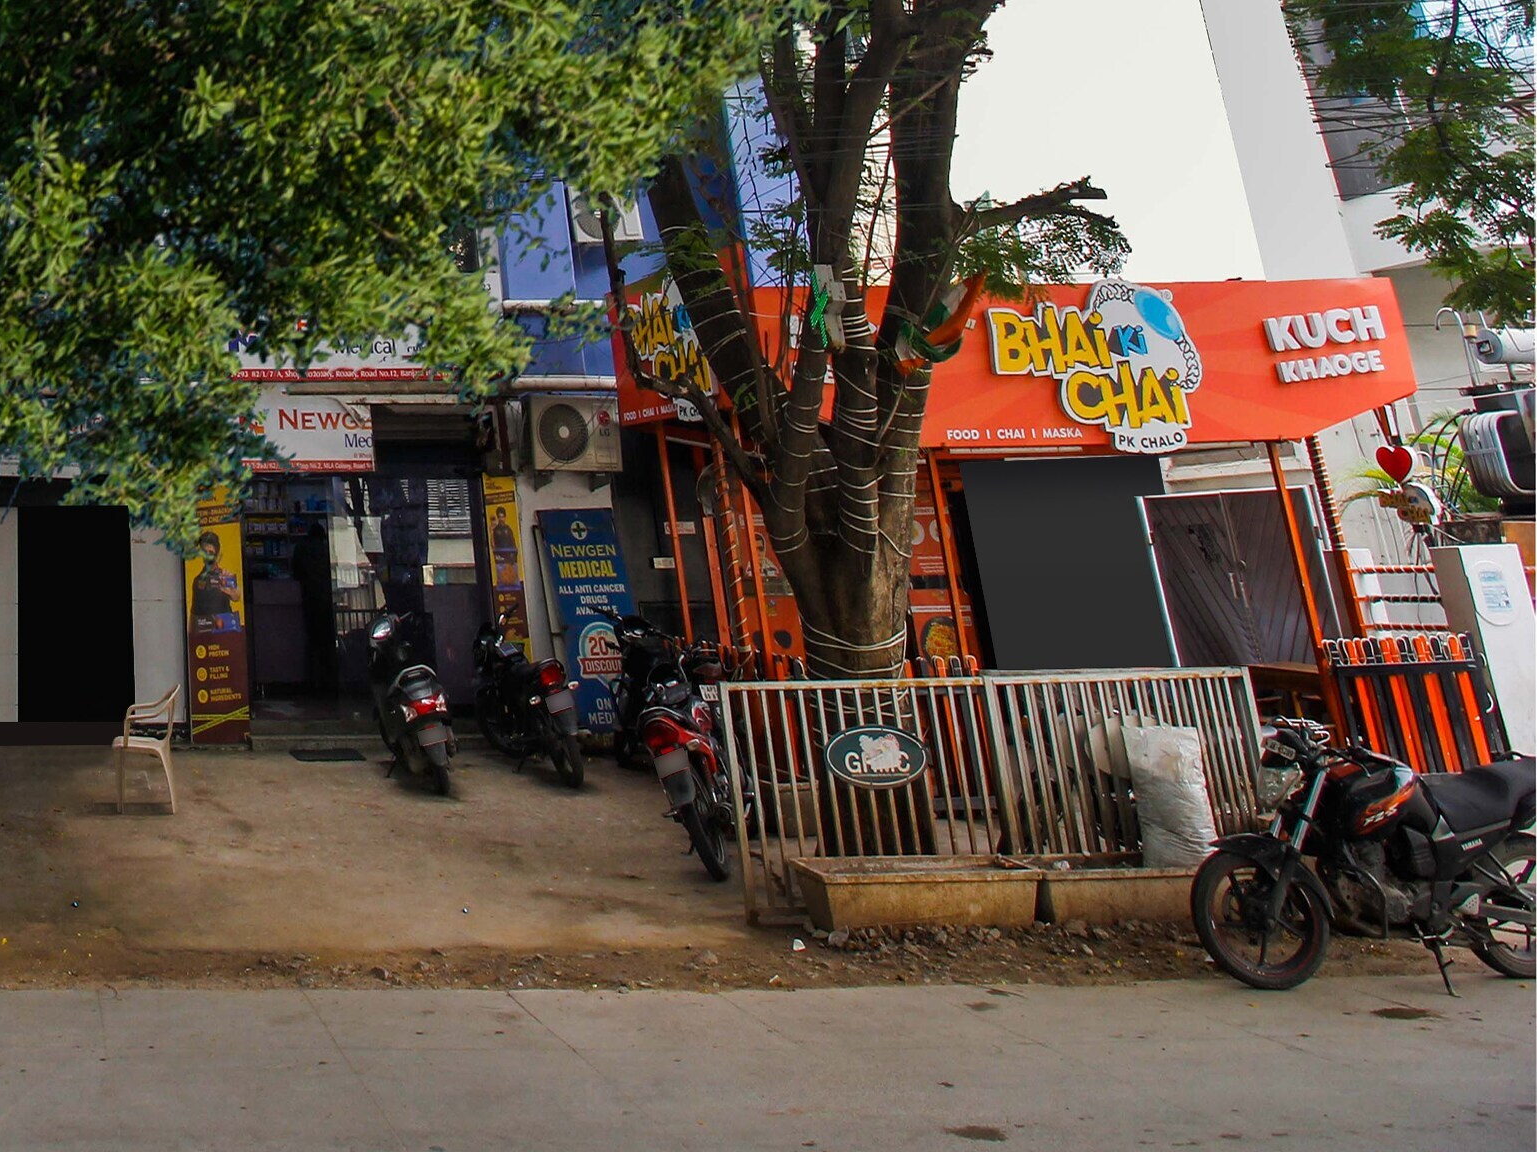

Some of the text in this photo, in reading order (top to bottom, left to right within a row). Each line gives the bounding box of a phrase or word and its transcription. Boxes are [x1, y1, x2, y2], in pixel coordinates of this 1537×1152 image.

[1263, 304, 1387, 353] KUCH
[360, 369, 378, 377] Road
[1276, 349, 1385, 384] KHAOGE
[623, 411, 638, 421] FOOD
[642, 407, 655, 418] CHAI
[679, 405, 689, 417] PK
[946, 428, 980, 441] FOOD
[997, 428, 1026, 440] CHAI
[1042, 427, 1083, 440] MASKA
[1118, 431, 1184, 449] PK CHALO
[550, 544, 616, 558] NEWGEN
[558, 560, 617, 578] MEDICAL
[559, 583, 625, 594] ALL ANTI CANCER
[580, 595, 608, 604] DRUGS
[596, 697, 612, 710] ON
